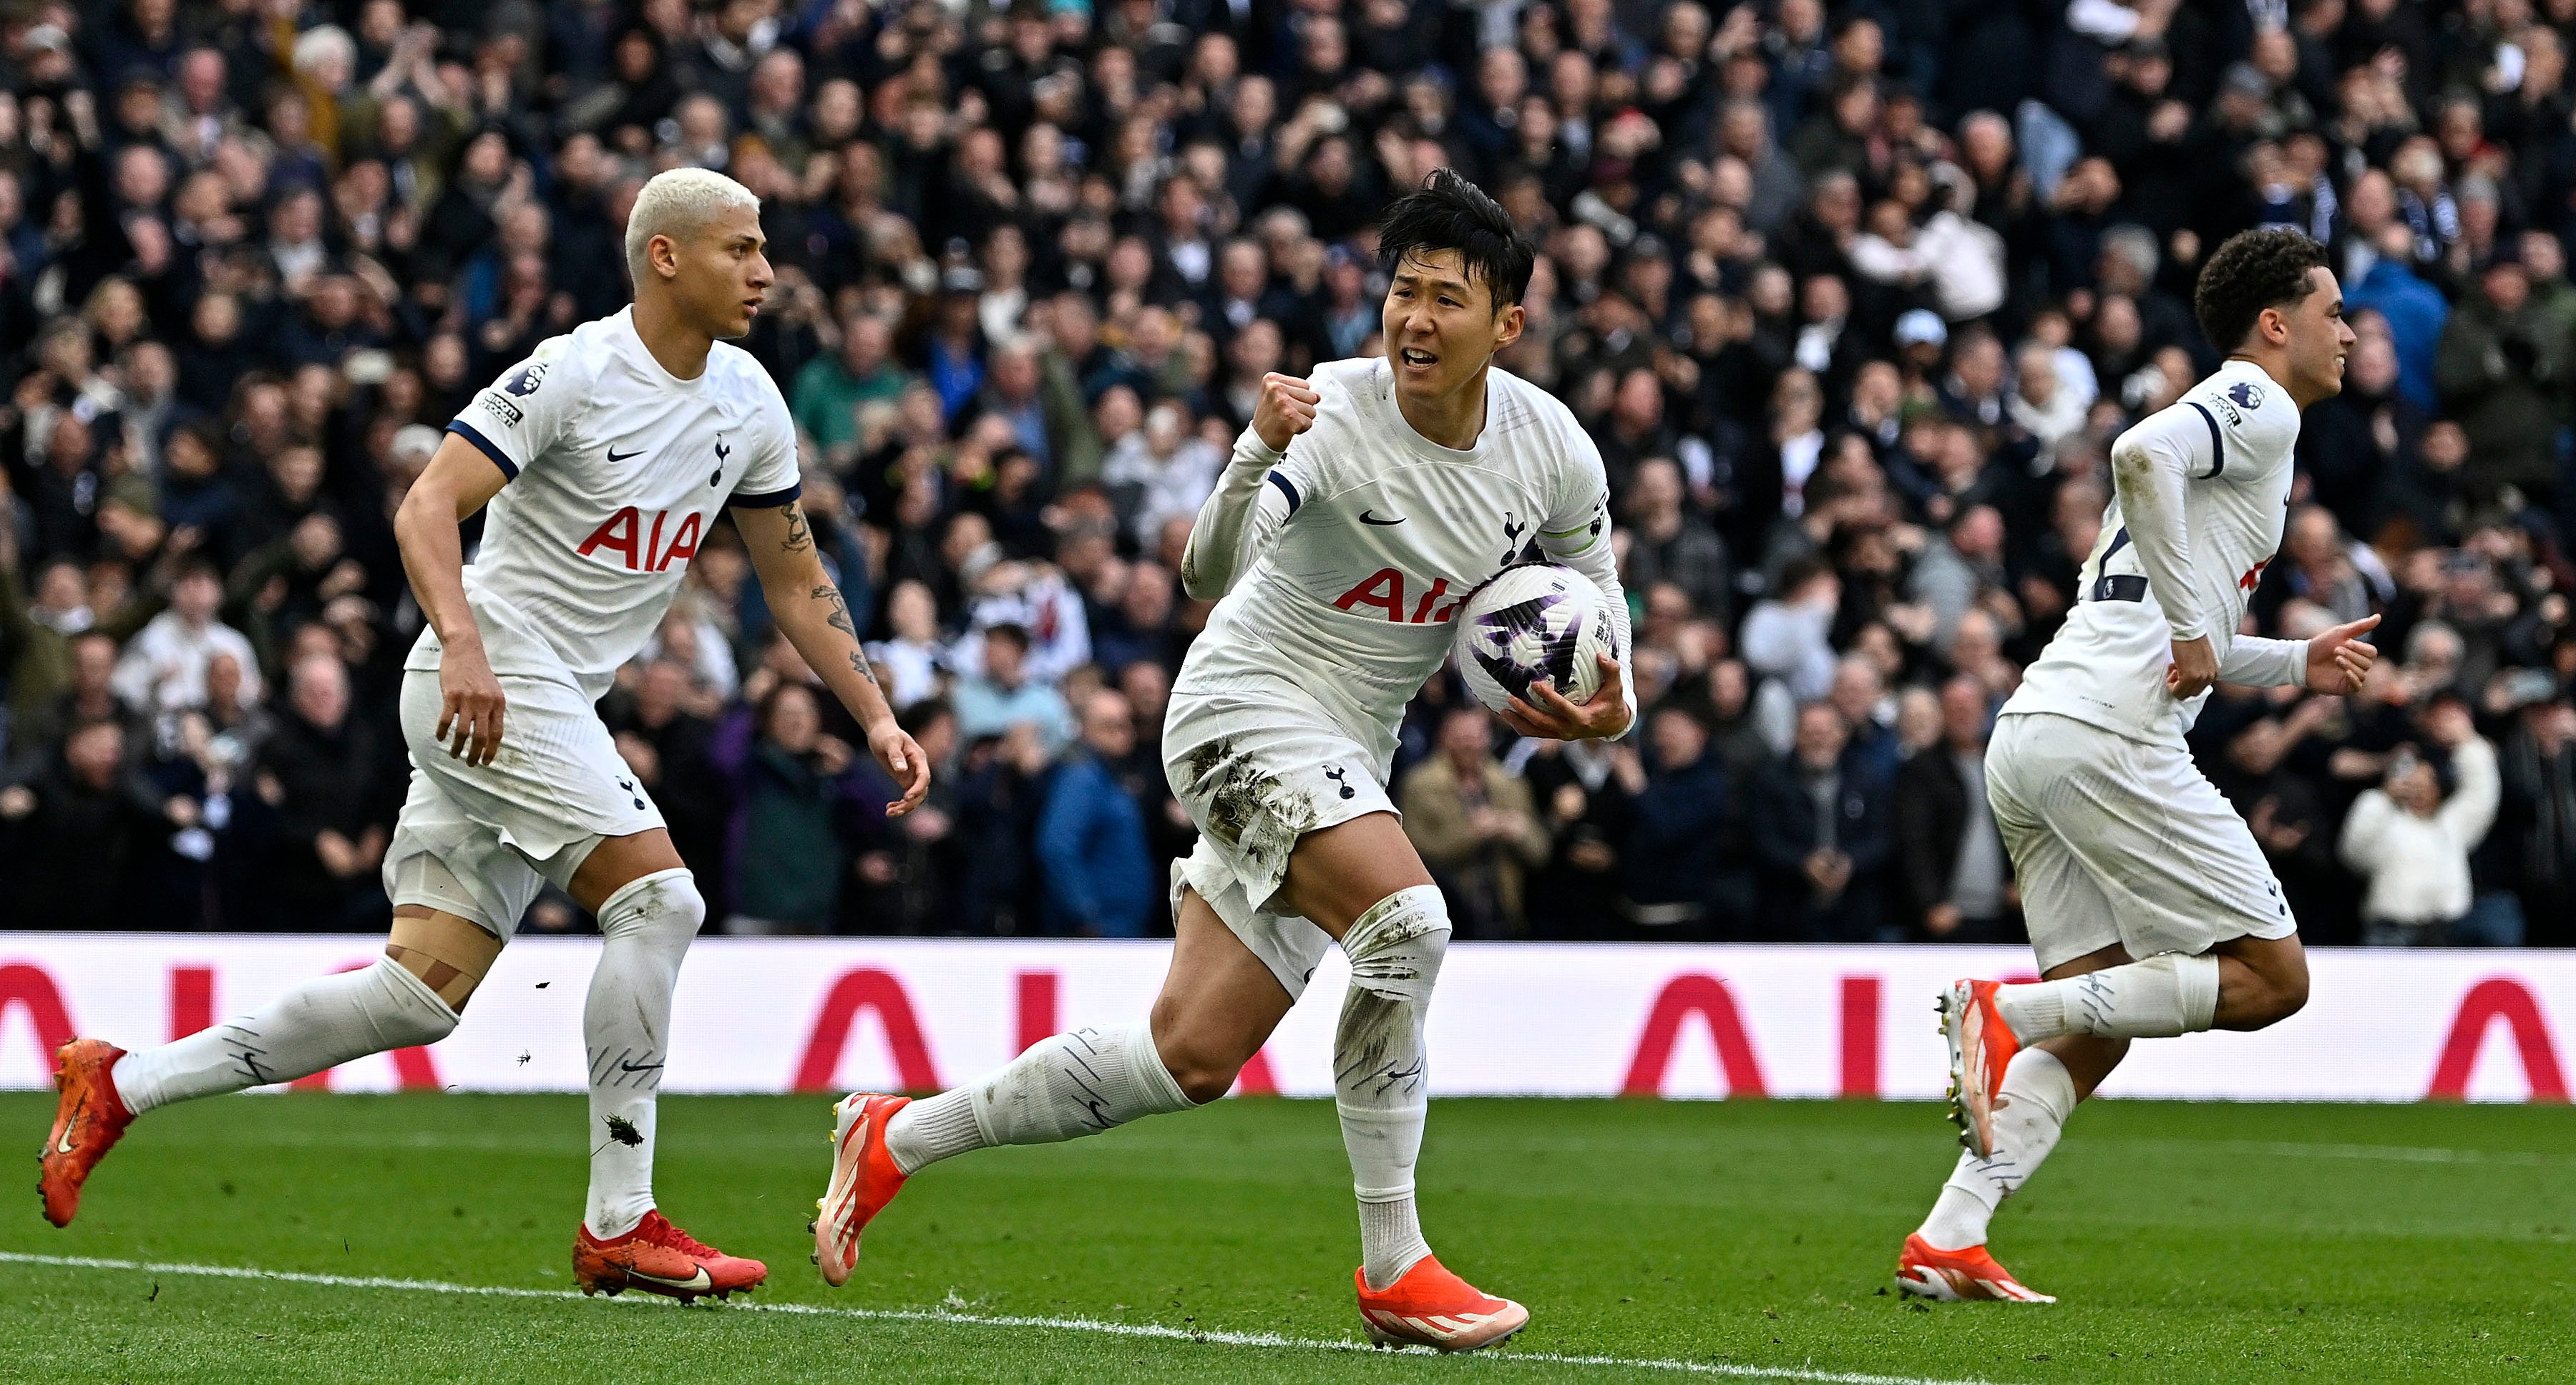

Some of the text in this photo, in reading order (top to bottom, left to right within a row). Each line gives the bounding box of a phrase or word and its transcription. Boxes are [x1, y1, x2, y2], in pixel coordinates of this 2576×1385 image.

[577, 506, 701, 571] AIA
[789, 968, 1281, 1097] AI
[1623, 975, 2046, 1099] AI
